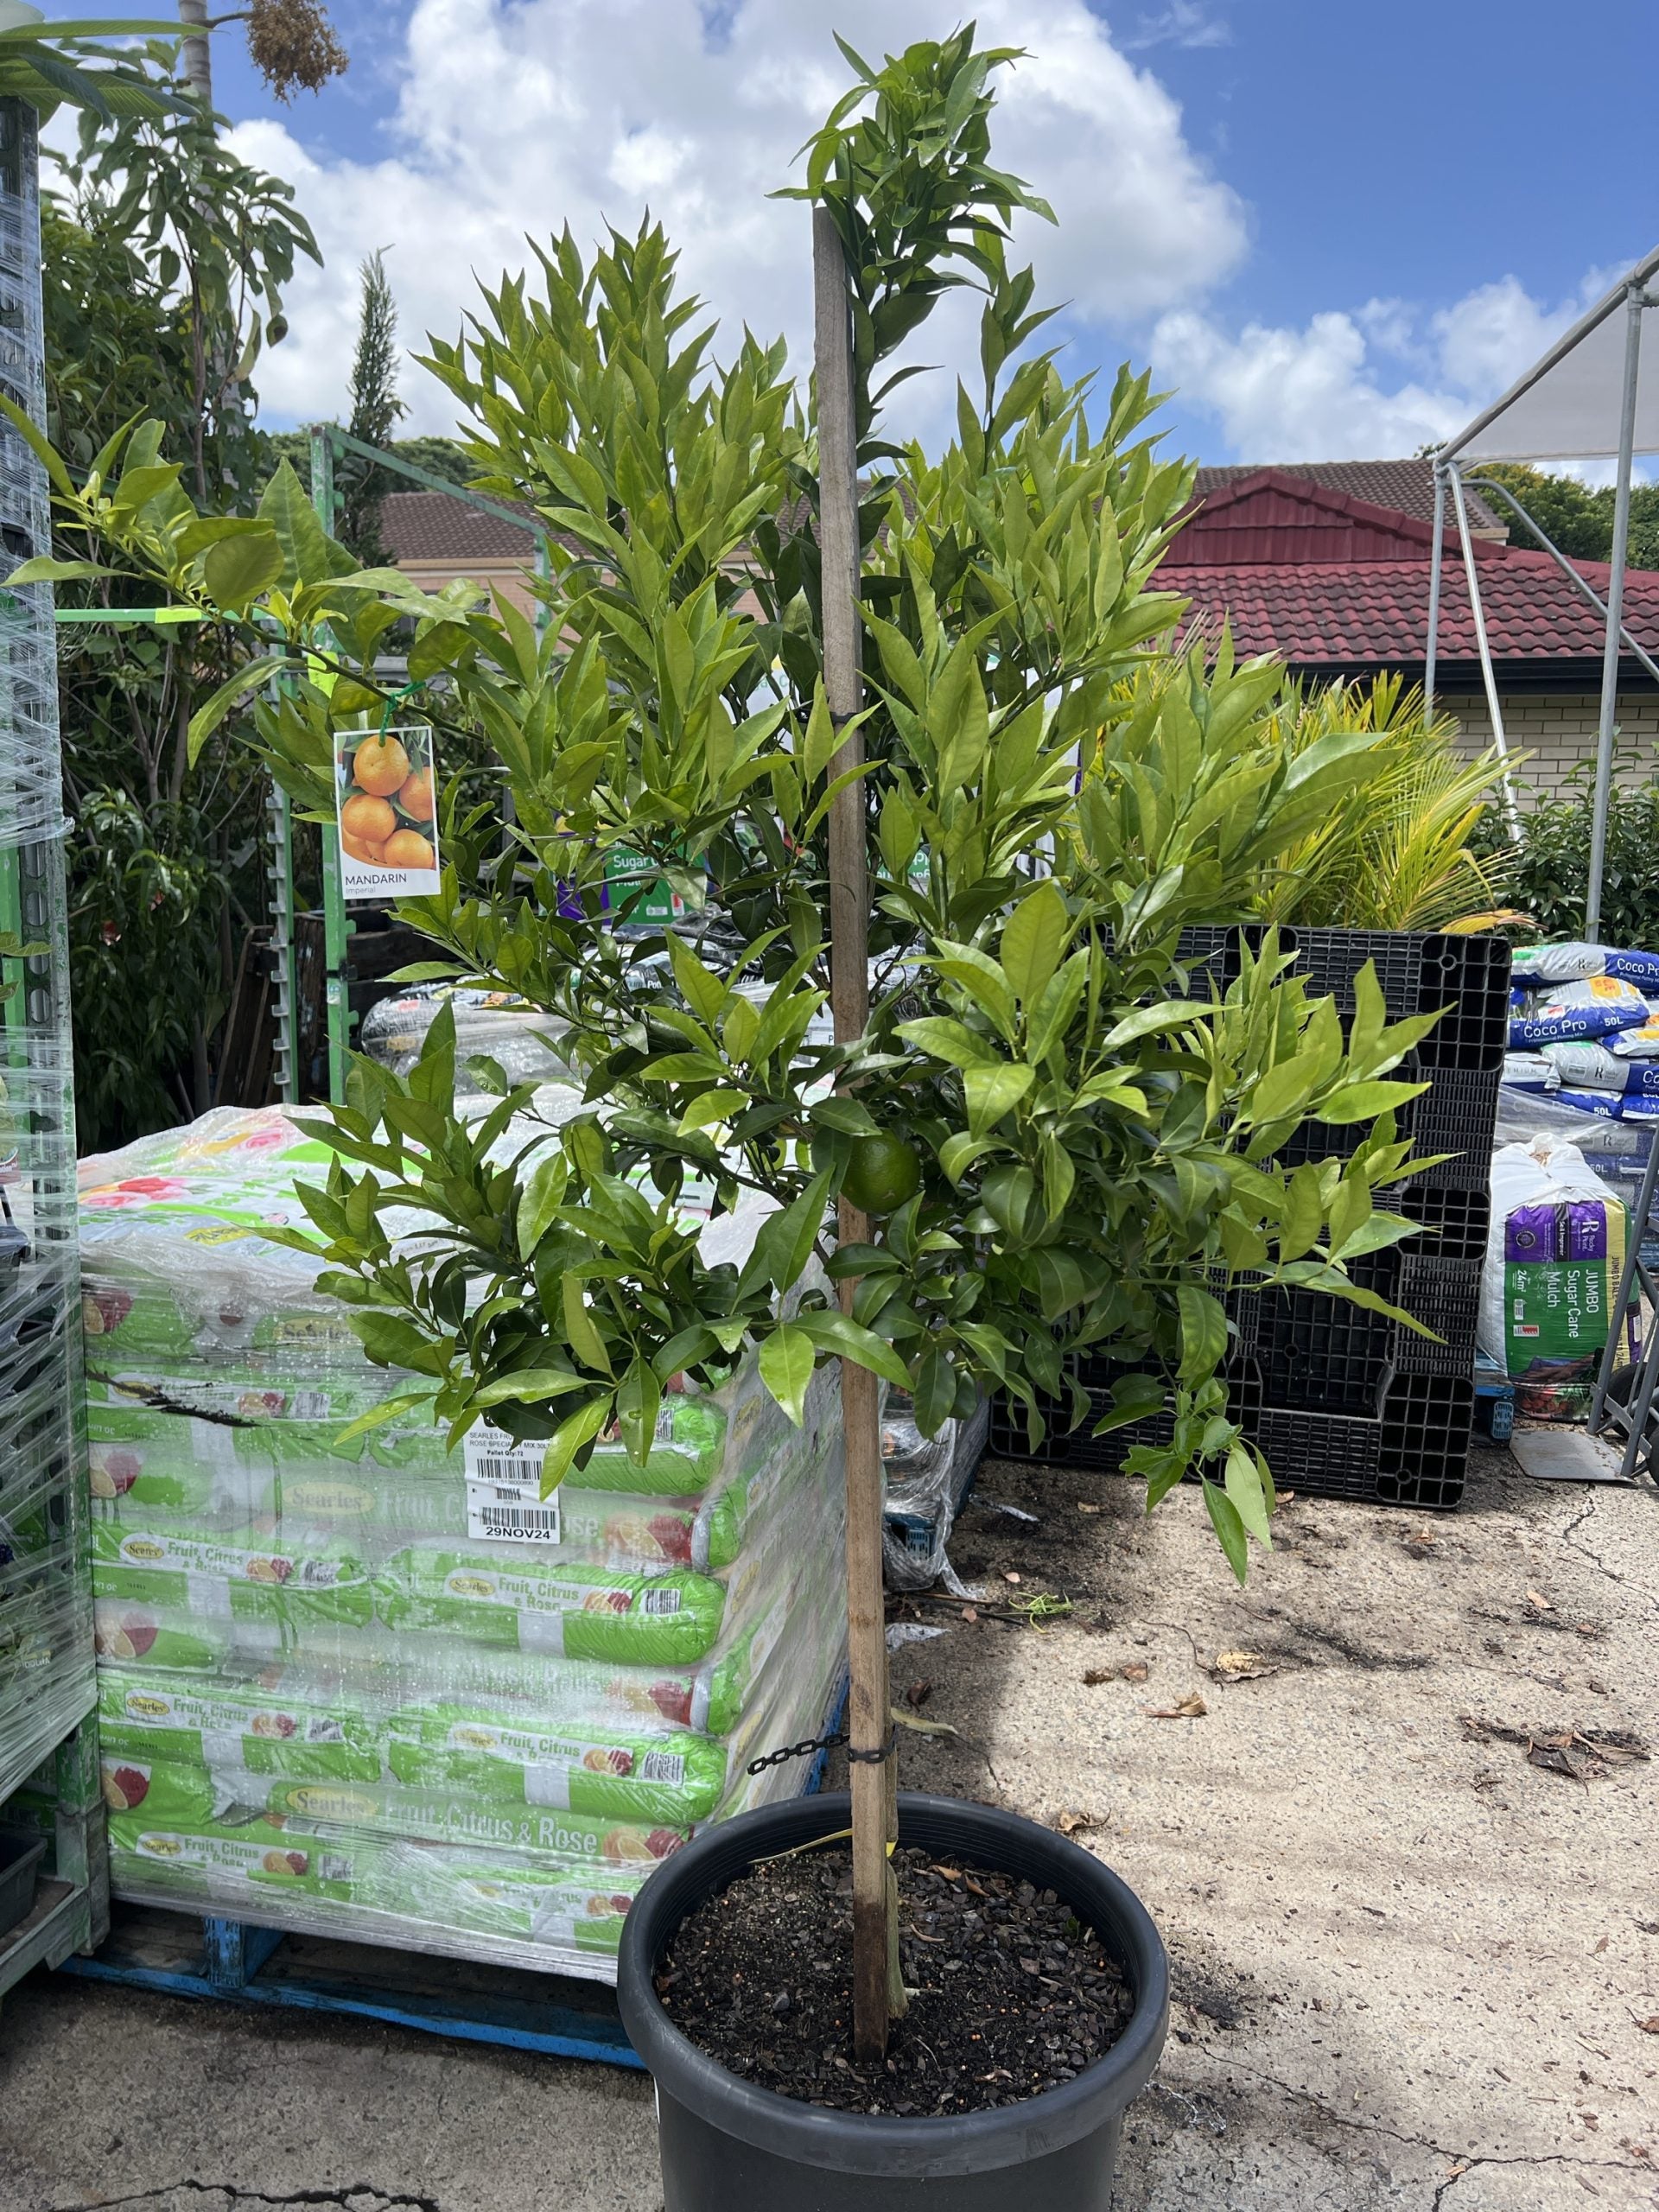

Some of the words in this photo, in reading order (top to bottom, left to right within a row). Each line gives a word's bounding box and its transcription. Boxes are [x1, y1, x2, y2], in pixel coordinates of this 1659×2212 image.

[613, 855, 650, 871] Sugar
[345, 873, 408, 886] MANDARIN
[346, 885, 376, 895] Imperial
[1617, 957, 1644, 974] Coco
[1647, 962, 1659, 976] Pr
[1523, 1025, 1558, 1039] Coco
[1561, 1019, 1586, 1033] Pro
[1604, 1017, 1624, 1027] 50L
[1593, 1107, 1612, 1117] 50L
[1611, 1255, 1620, 1280] JUMBO
[1547, 1270, 1562, 1307] Mulch
[1563, 1269, 1580, 1306] Sugar
[1585, 1268, 1599, 1314] JUMBO
[1567, 1307, 1581, 1338] Cane
[292, 1486, 364, 1510] Searles
[486, 1525, 551, 1540] 29NOV24
[205, 1546, 244, 1566] Citrus
[456, 1579, 488, 1594] Searles
[537, 1582, 580, 1601] Citrus
[131, 1698, 165, 1713] Searles
[210, 1703, 249, 1722] Citrus
[538, 1738, 581, 1758] Citrus
[296, 1789, 366, 1814] Searles
[446, 1802, 513, 1841] Citrus
[518, 1821, 532, 1843] &
[538, 1816, 598, 1854] Rose
[221, 1841, 259, 1859] Citrus
